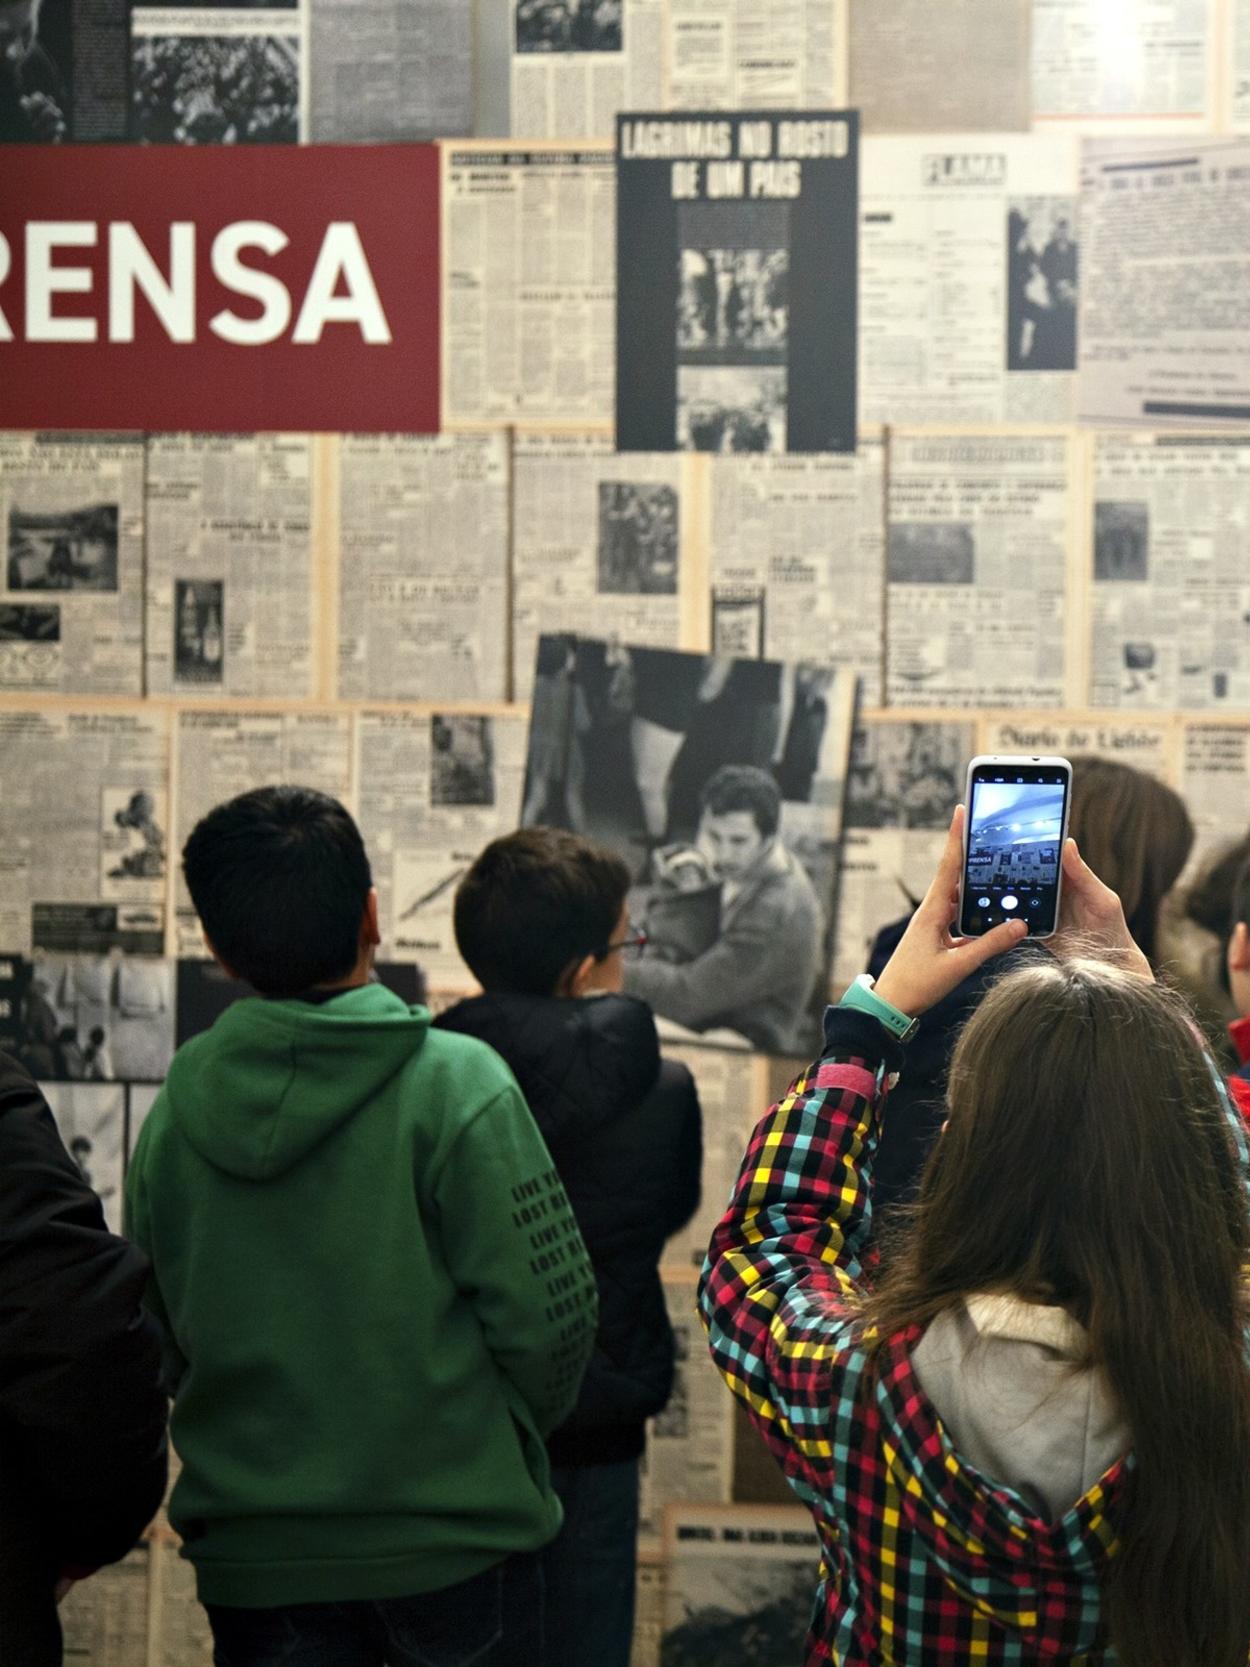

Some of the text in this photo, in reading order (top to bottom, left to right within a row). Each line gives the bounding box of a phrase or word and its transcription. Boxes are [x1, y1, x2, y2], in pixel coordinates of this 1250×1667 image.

[738, 121, 773, 158] NO
[671, 161, 700, 199] DE
[706, 161, 744, 198] UM
[0, 221, 392, 345] ENSA
[511, 1178, 541, 1203] LIVE
[512, 1200, 548, 1230] LOST
[529, 1223, 560, 1250] LIVE
[529, 1247, 565, 1275] LOST
[547, 1270, 577, 1297] LIVE
[546, 1292, 582, 1322] LOST
